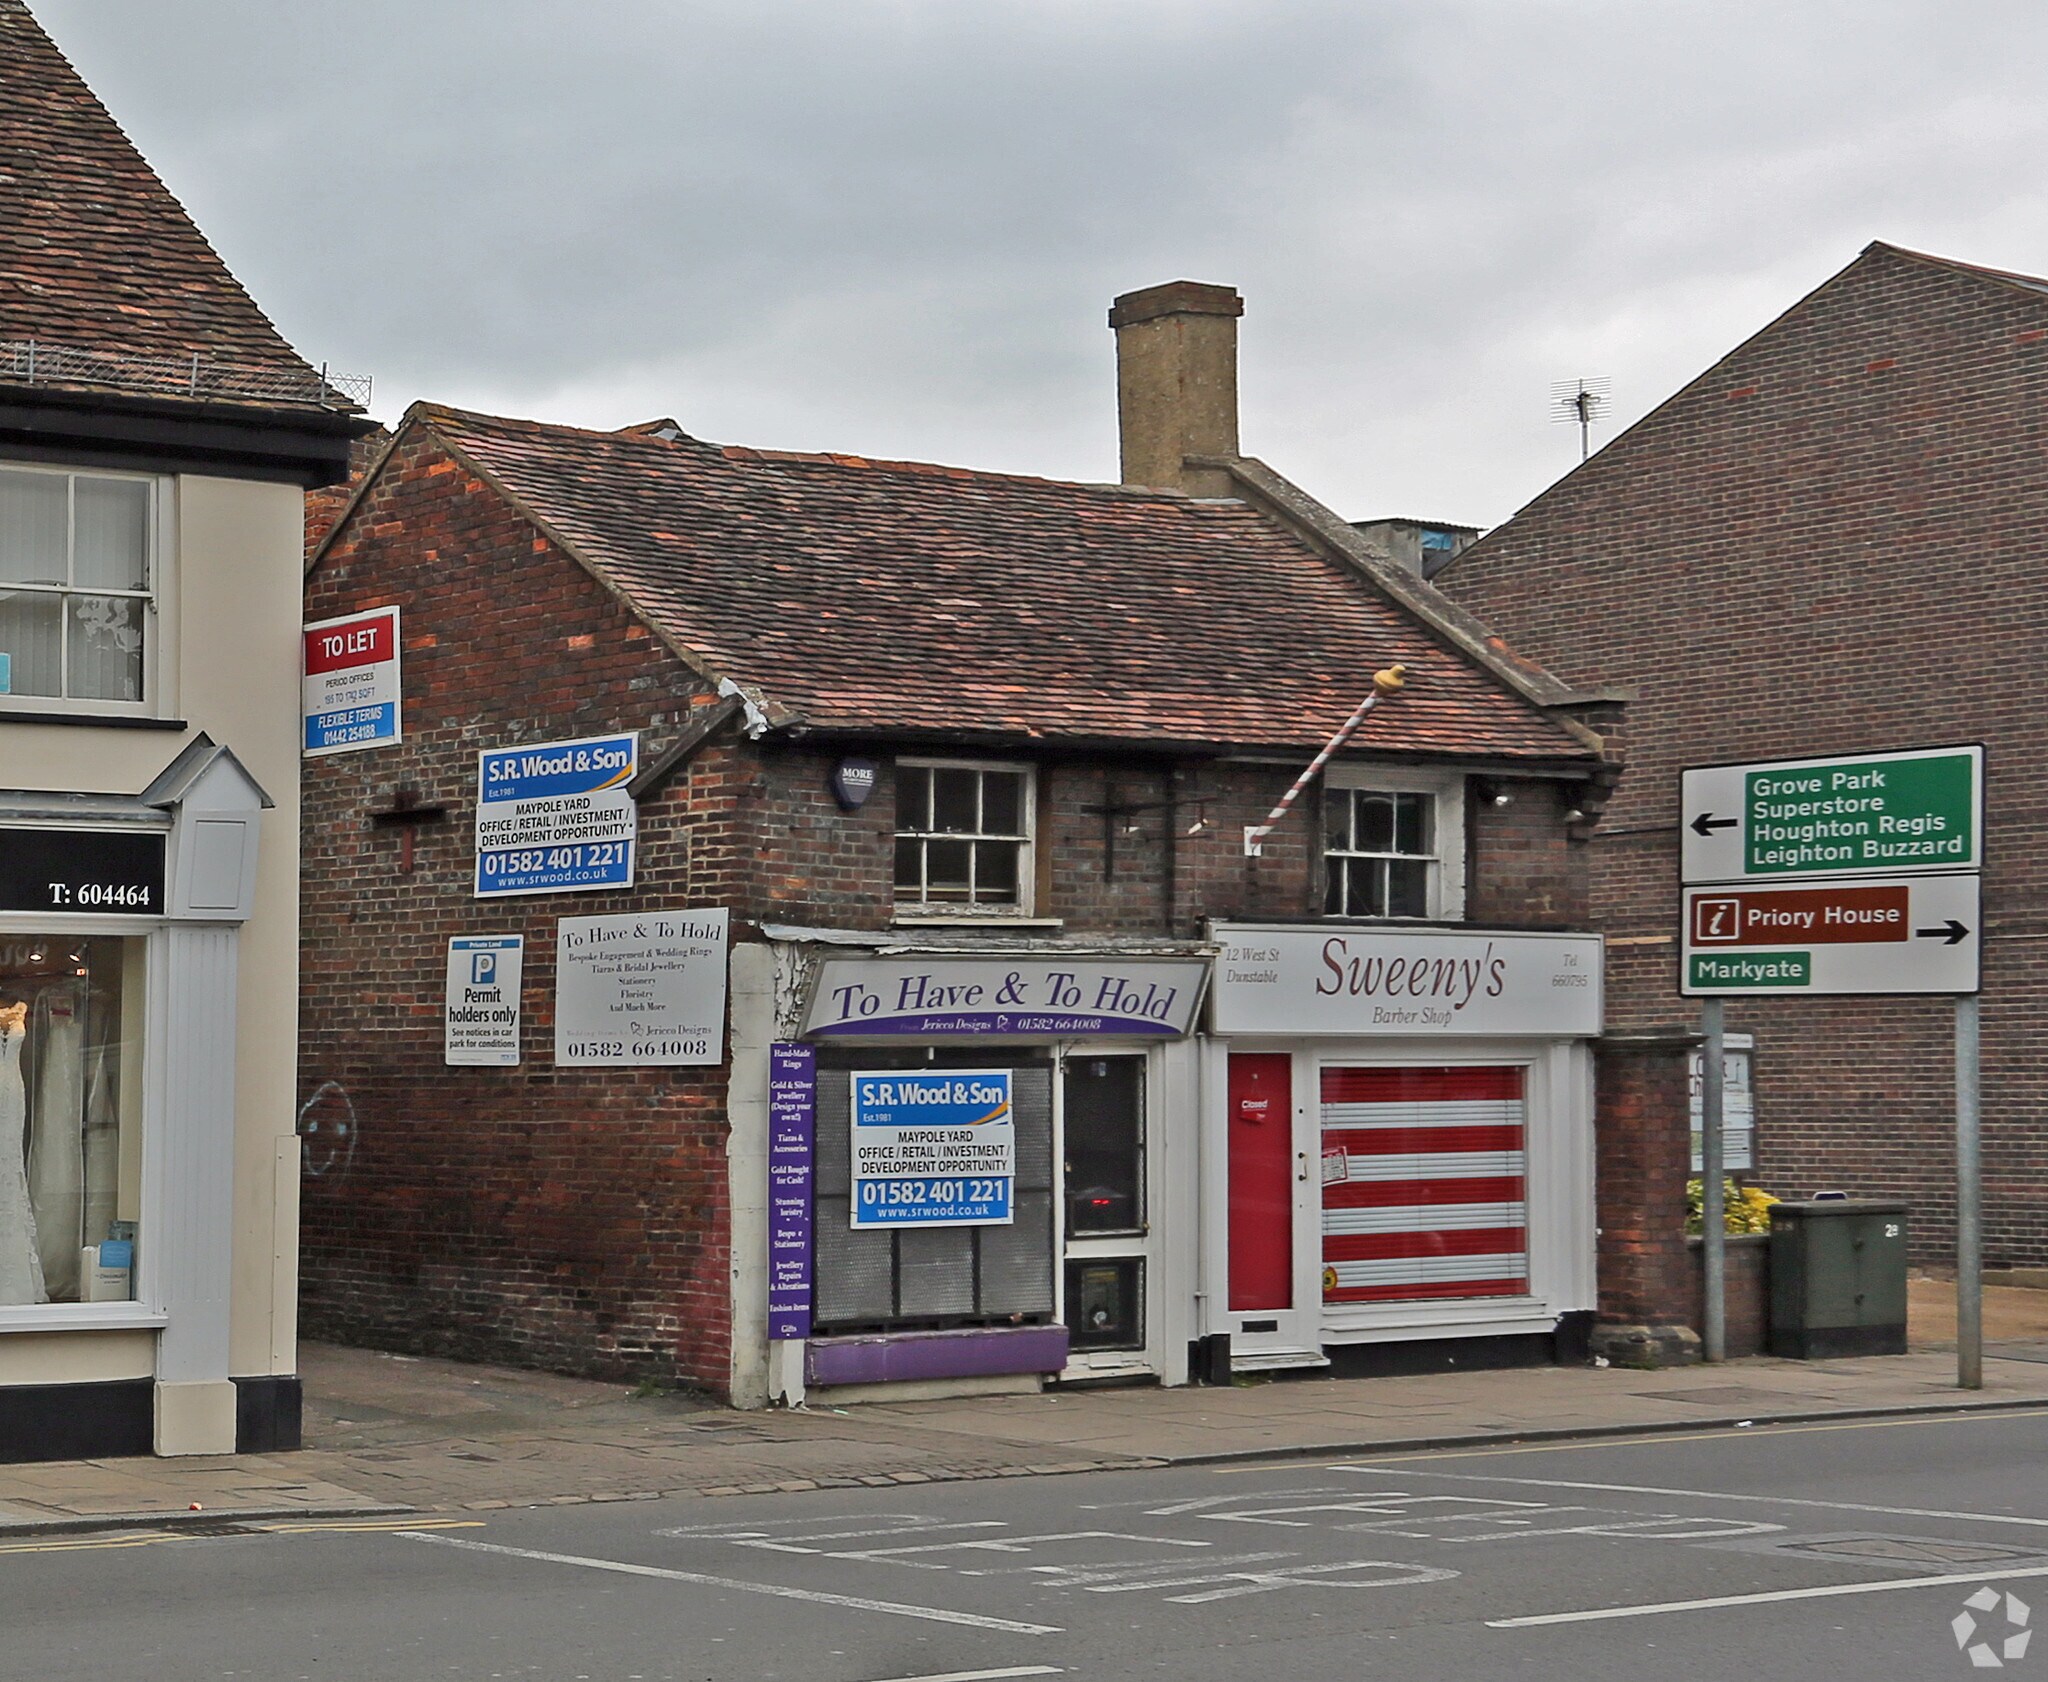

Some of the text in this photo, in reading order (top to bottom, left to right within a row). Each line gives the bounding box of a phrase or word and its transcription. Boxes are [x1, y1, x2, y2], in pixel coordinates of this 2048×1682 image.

[322, 628, 377, 658] TO LET
[326, 672, 374, 688] PERIOD OFFICES
[336, 692, 344, 702] TO
[318, 706, 383, 728] FLEXIBLE TERMS
[324, 724, 376, 745] 01442 254188
[488, 748, 627, 782] S.R. Wood & Son
[843, 768, 873, 779] MORE
[1754, 770, 1886, 796] Grove Park
[516, 798, 590, 815] MAYPOLE YARD
[1754, 796, 1884, 821] Superstore
[480, 820, 512, 832] OFFICE
[519, 818, 551, 829] RETAIL
[559, 809, 623, 825] INVESTMENT
[1754, 813, 1945, 843] Houghton Regis
[482, 823, 626, 846] DEVELOPMENT OPPORTUNITY
[1754, 835, 1962, 867] Leighton Buzzard
[485, 844, 624, 875] 01582 401 221
[498, 868, 608, 886] www.srwood.co.uk
[49, 883, 149, 905] T: 604464
[1748, 909, 1815, 929] Priory
[1825, 906, 1900, 924] House
[563, 922, 721, 948] To Have & To Hold
[569, 947, 712, 964] Bespoke Engagement & Wedding Rings
[1226, 949, 1279, 962] 12 West St
[1562, 954, 1577, 966] Tel
[592, 962, 684, 974] Tiaras & Bridal Jewellery
[1316, 938, 1505, 1010] Sweeny's
[1699, 961, 1803, 982] Markyate
[618, 977, 655, 987] Stationery
[1227, 971, 1278, 983] Dunstable
[465, 987, 500, 1002] Permit
[620, 990, 653, 1000] Floristry
[833, 972, 1176, 1021] To Have & To Hold
[610, 1002, 666, 1012] And Much More
[450, 1006, 516, 1026] holders only
[1372, 1007, 1452, 1026] Barber Shop
[452, 1028, 464, 1036] See
[466, 1028, 490, 1036] notices
[493, 1028, 499, 1036] in
[646, 1026, 676, 1036] Jericco
[678, 1025, 711, 1037] Designs
[921, 1018, 954, 1031] Jericco
[956, 1018, 991, 1032] Designs
[1018, 1018, 1053, 1030] 01582
[1055, 1018, 1100, 1030] 664008
[450, 1040, 464, 1049] park
[478, 1040, 515, 1048] conditions
[568, 1041, 706, 1057] 01582 664008
[774, 1049, 810, 1057] Hand-Made
[783, 1060, 801, 1069] Rings
[777, 1092, 805, 1101] Jewellery
[863, 1082, 1002, 1106] S.R. Wood & Son
[1242, 1099, 1268, 1108] Closed
[899, 1131, 973, 1142] MAYPOLE YARD
[859, 1148, 894, 1158] OFFICE
[902, 1146, 935, 1158] RETAIL
[944, 1145, 1004, 1157] INVESTMENT
[771, 1166, 809, 1176] Gold Bought
[862, 1160, 1007, 1173] DEVELOPMENT OPPORTUNITY
[777, 1176, 788, 1184] for
[863, 1180, 1003, 1204] 01582 401 221
[775, 1198, 805, 1207] Stunning
[878, 1204, 988, 1217] www.srwood.co.uk
[774, 1241, 805, 1249] Stationery
[776, 1261, 803, 1271] Jewellery
[779, 1272, 801, 1281] Repairs
[770, 1304, 792, 1312] Fashion
[1077, 1488, 1788, 1541] KEEP
[651, 1514, 1461, 1602] CLEAR
